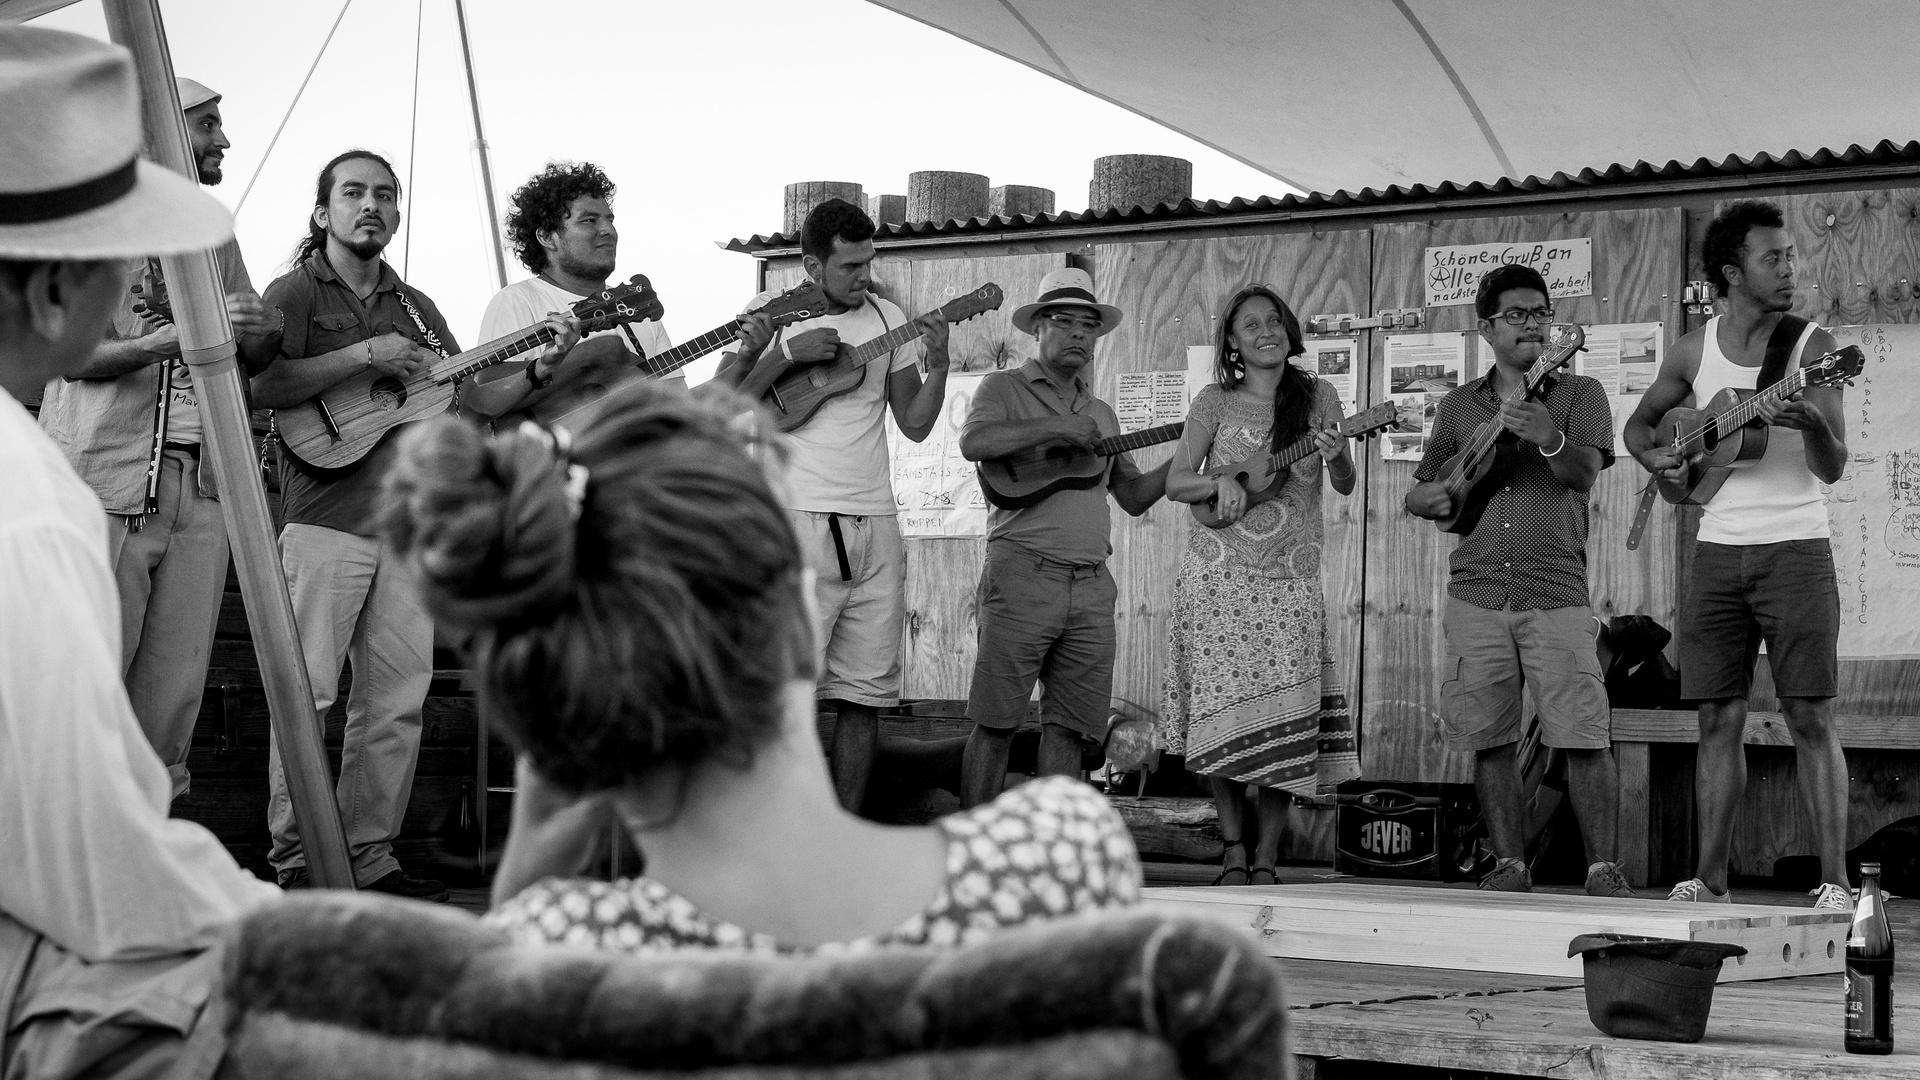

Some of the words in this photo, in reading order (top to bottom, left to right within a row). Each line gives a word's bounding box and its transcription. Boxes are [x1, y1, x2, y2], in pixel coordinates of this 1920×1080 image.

[1547, 248, 1572, 260] an
[895, 466, 951, 480] SAMSTAGS
[1361, 820, 1413, 855] JEVER
